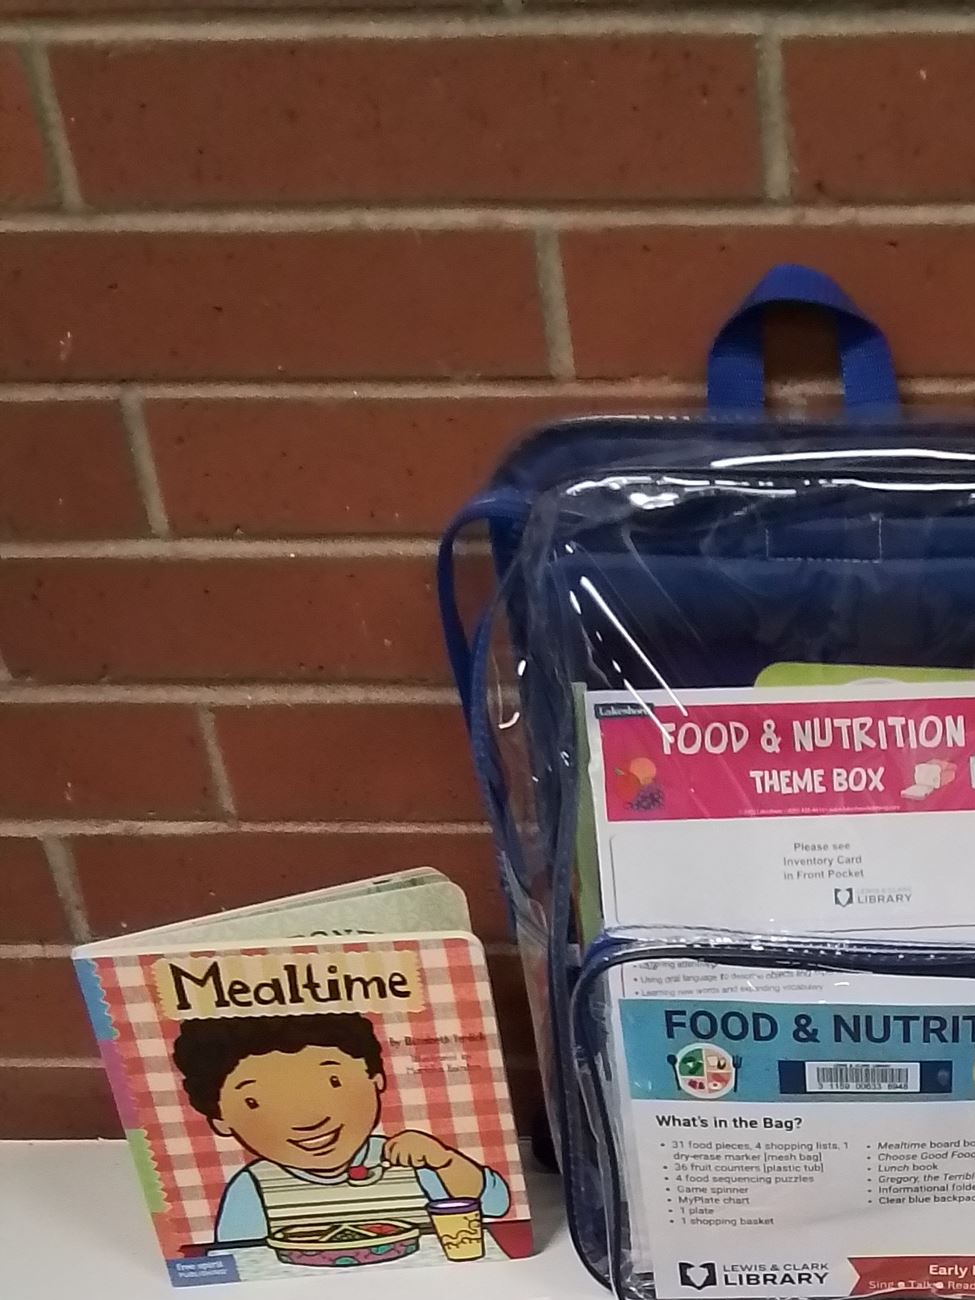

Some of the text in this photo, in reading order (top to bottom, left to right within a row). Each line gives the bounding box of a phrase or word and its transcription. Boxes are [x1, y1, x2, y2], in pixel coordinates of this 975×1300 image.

[660, 715, 966, 755] FOOD & NUTRITION
[749, 766, 885, 794] THEME BOX
[793, 842, 850, 852] Please see
[783, 855, 862, 867] Inventory Card
[783, 869, 864, 880] in Front Pocket
[857, 893, 912, 904] LIBRARY
[169, 960, 412, 1010] Mealtime
[664, 1009, 778, 1042] FOOD
[792, 1014, 821, 1043] &
[656, 1114, 803, 1131] What's in the Bag?
[672, 1141, 685, 1149] 31
[688, 1141, 713, 1150] food
[755, 1142, 762, 1150] 4
[765, 1142, 813, 1151] shopping
[877, 1141, 927, 1150] Mealtime
[929, 1139, 960, 1149] board
[673, 1152, 722, 1161] dry-erase
[724, 1152, 760, 1161] marker
[878, 1152, 917, 1161] Choose
[920, 1151, 949, 1160] Good
[674, 1163, 688, 1171] 36
[690, 1163, 712, 1172] fruit
[714, 1164, 761, 1172] counters
[878, 1162, 938, 1173] Lunch book
[685, 1174, 709, 1182] food
[712, 1175, 772, 1184] sequencing
[775, 1175, 814, 1184] puzzles
[923, 1173, 939, 1182] the
[677, 1186, 749, 1195] Game spinner
[878, 1184, 949, 1194] Informational
[678, 1196, 750, 1205] MyPlate chart
[878, 1196, 905, 1205] Clear
[908, 1195, 931, 1204] blue
[689, 1207, 714, 1215] plate
[690, 1218, 737, 1227] shopping
[723, 1263, 829, 1272] LEWIS & CLARK
[929, 1264, 968, 1278] Early
[724, 1272, 829, 1286] LIBRARY
